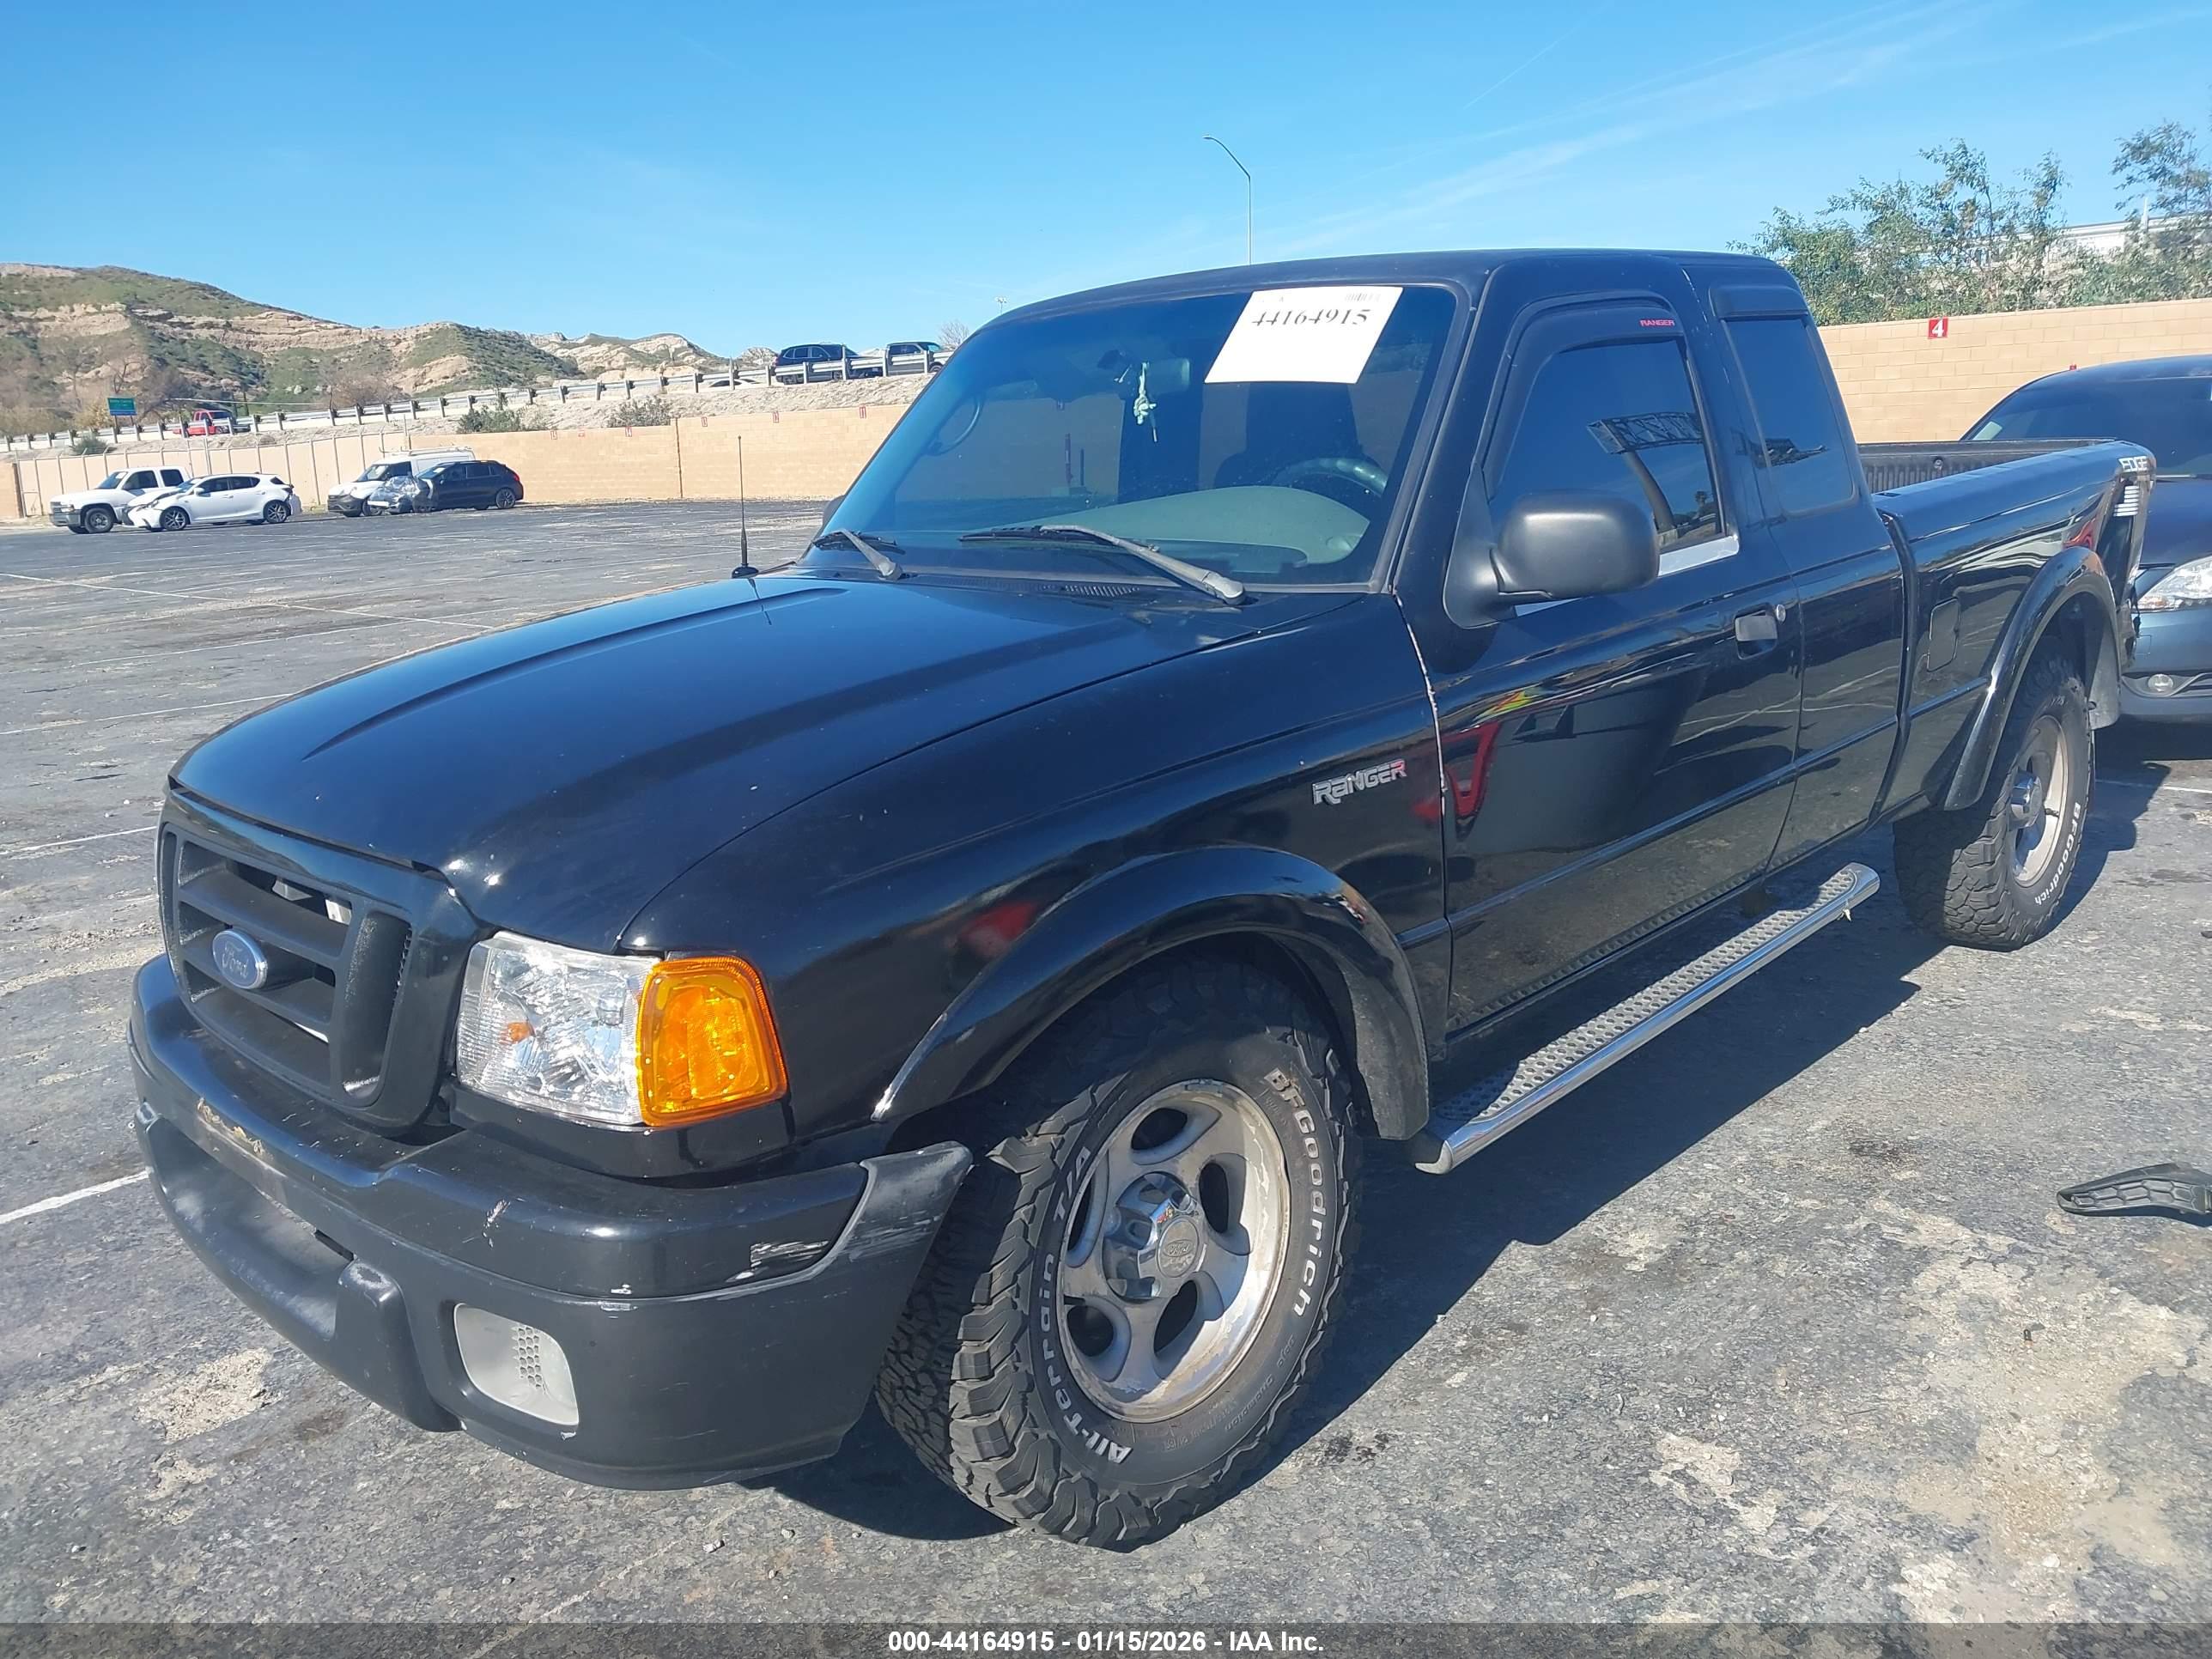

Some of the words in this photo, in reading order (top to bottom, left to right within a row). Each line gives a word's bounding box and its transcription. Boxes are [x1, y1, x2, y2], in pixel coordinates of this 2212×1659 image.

[1251, 308, 1371, 326] 44164915
[1931, 318, 1945, 337] 4
[2118, 455, 2148, 473] EDGE
[1312, 759, 1407, 805] RANGER
[2034, 802, 2081, 906] BFGoodrich
[221, 939, 250, 980] Ford
[1264, 1067, 1327, 1317] BFGoodrich
